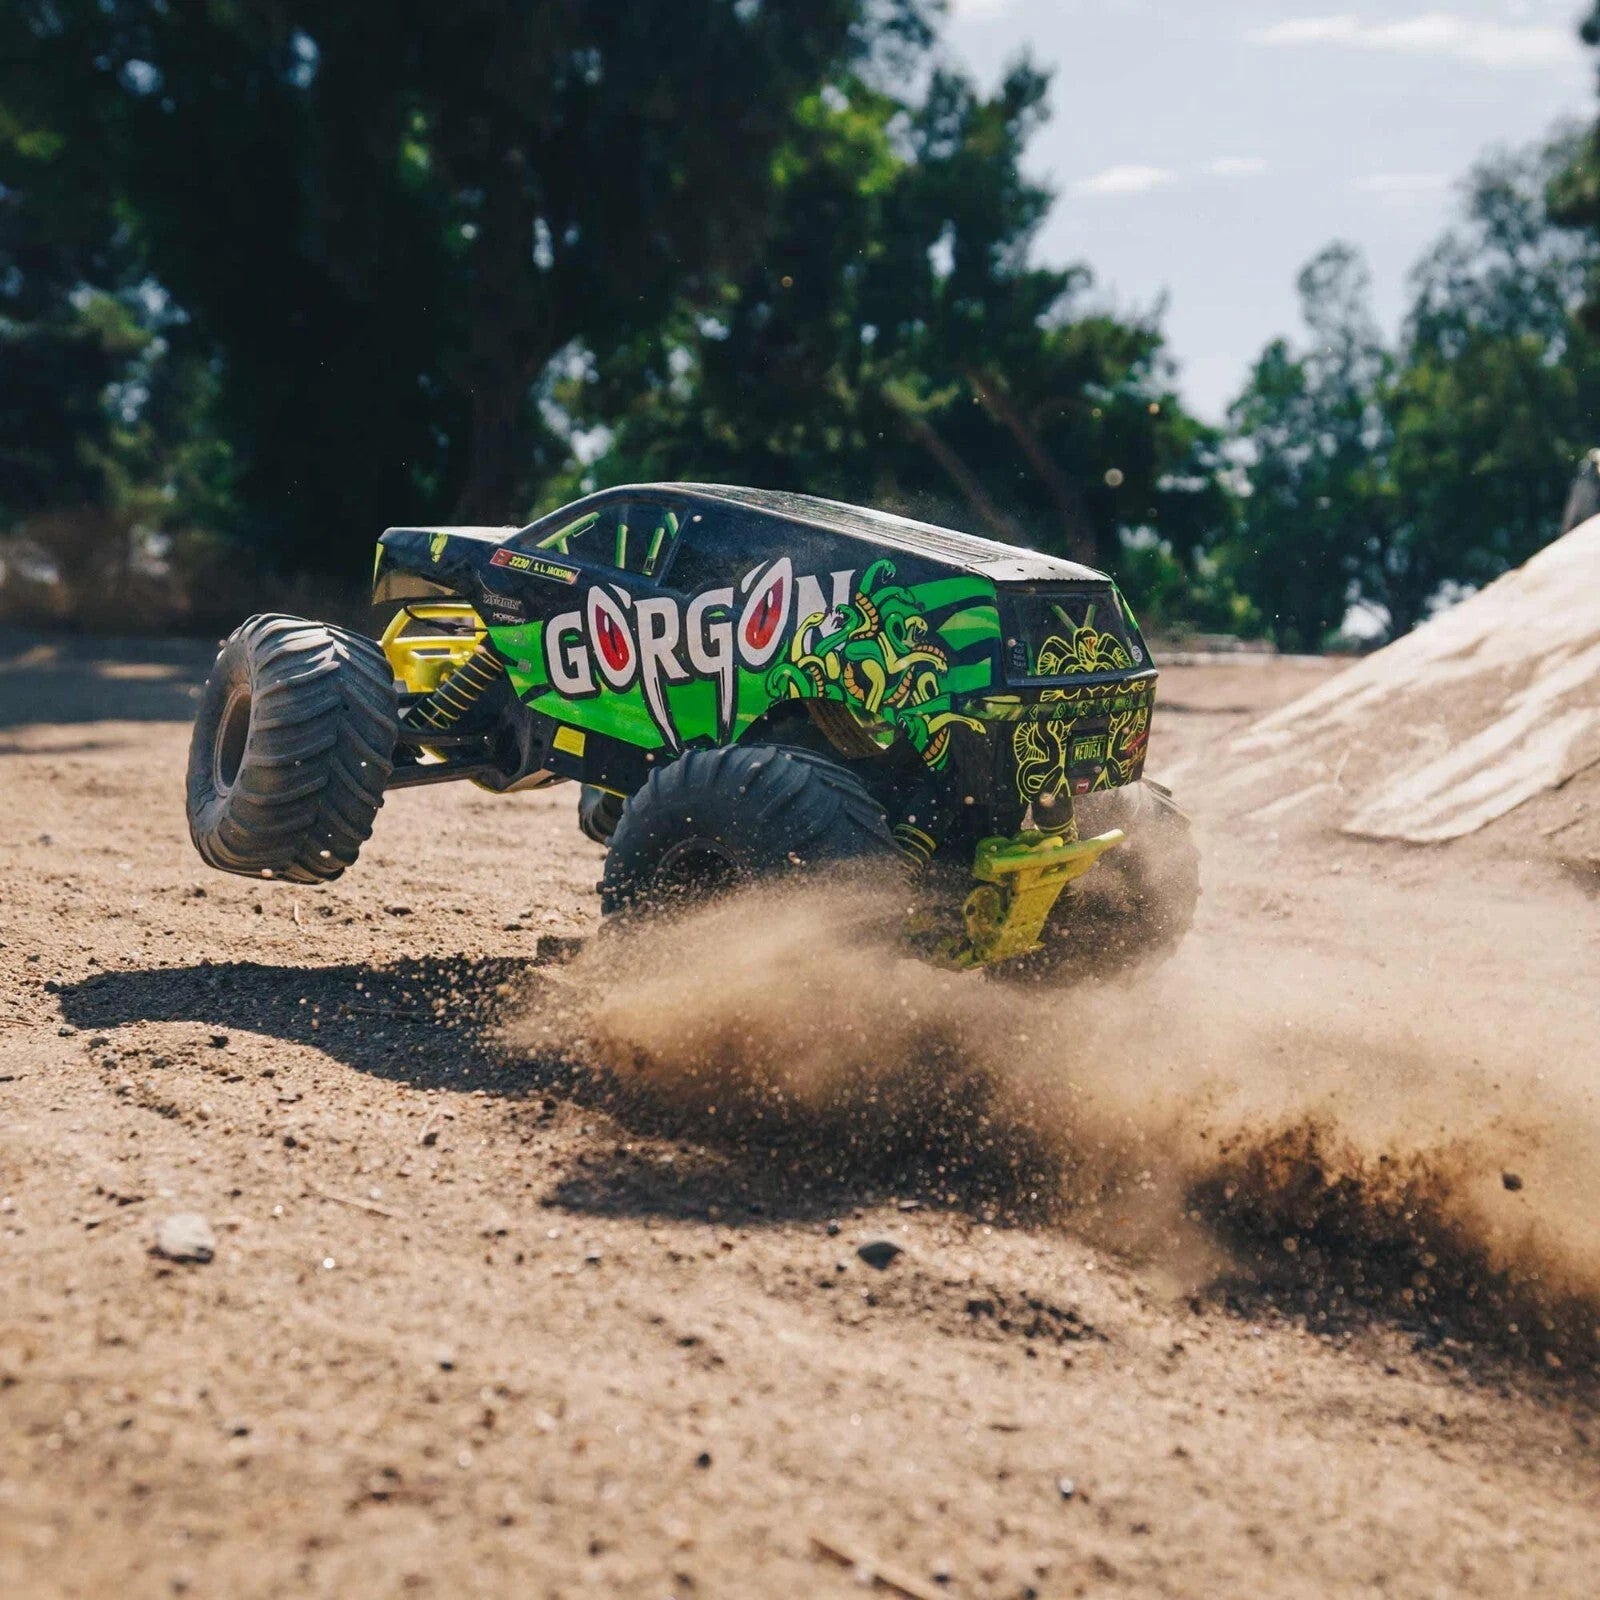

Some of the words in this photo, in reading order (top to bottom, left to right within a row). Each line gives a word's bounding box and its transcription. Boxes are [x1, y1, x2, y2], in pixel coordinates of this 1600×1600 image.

[546, 565, 573, 578] JACKSON
[546, 557, 856, 752] GORGON
[1073, 742, 1102, 761] MEDUSA
